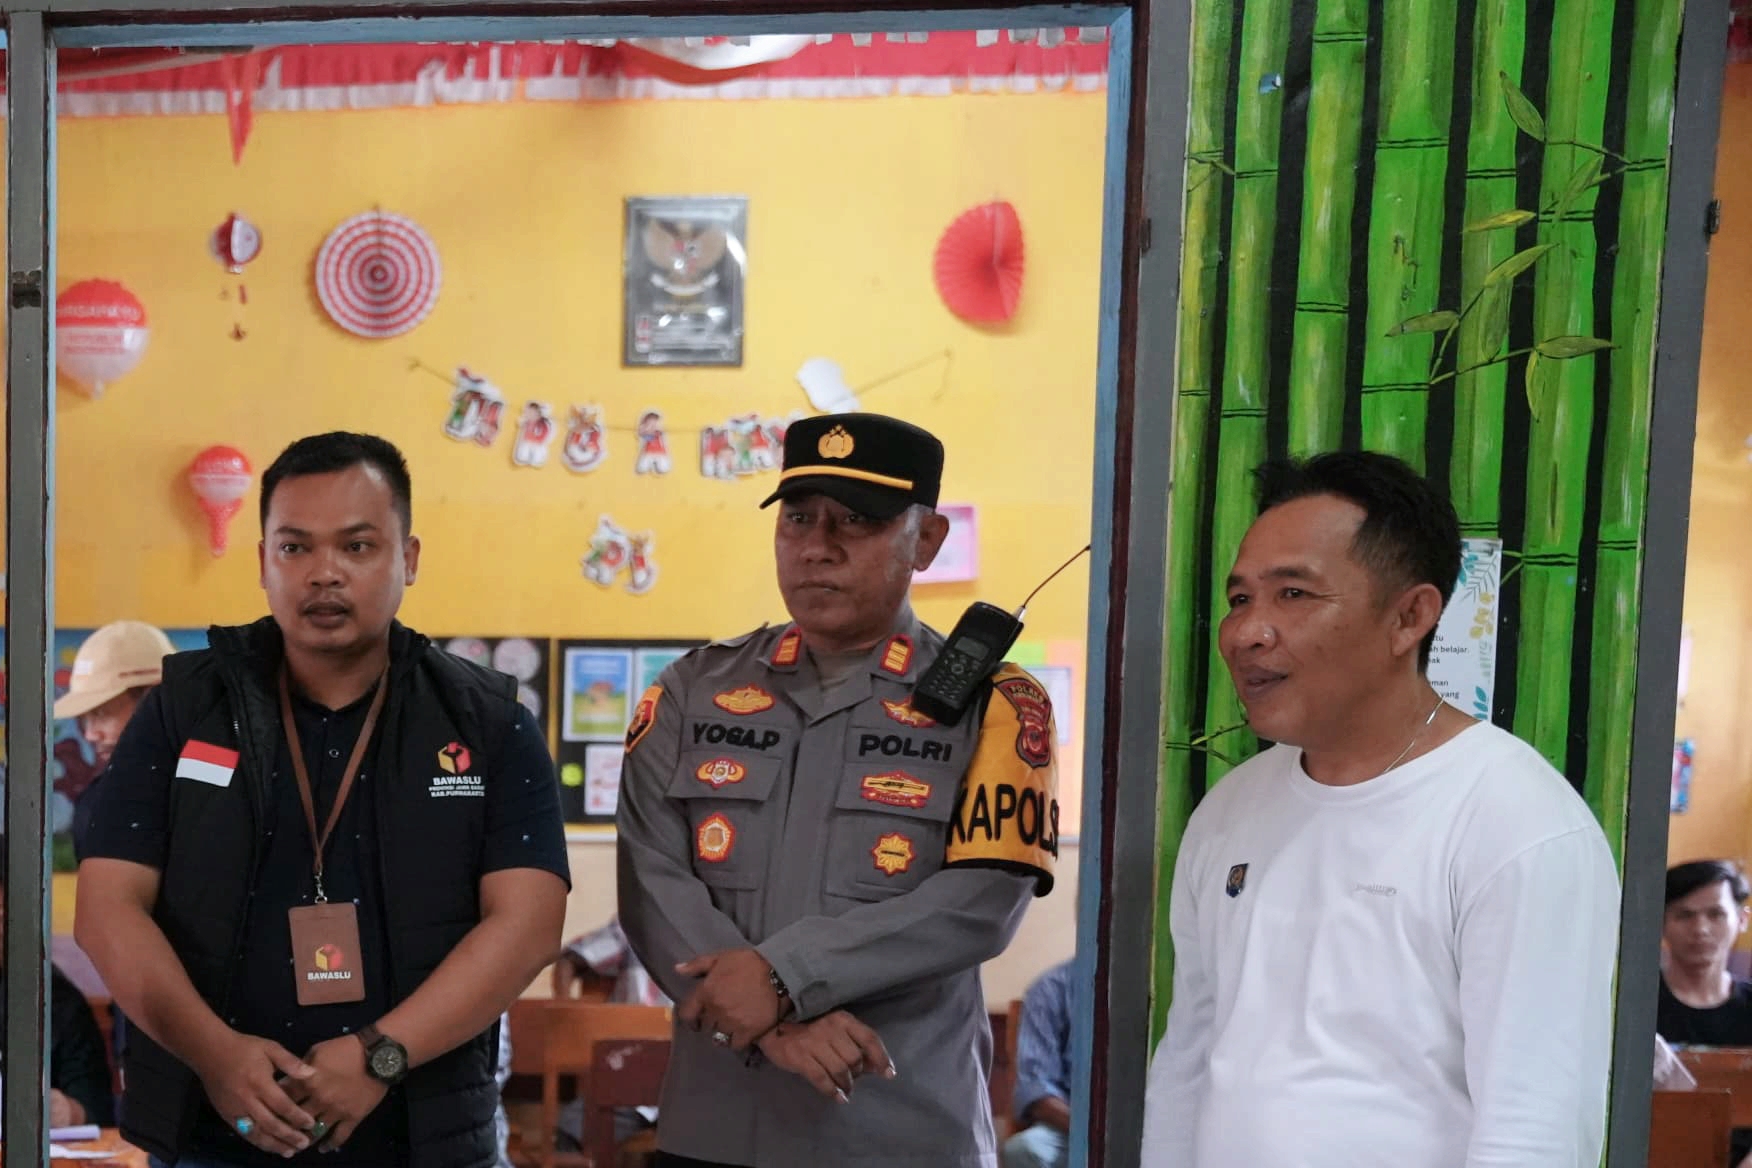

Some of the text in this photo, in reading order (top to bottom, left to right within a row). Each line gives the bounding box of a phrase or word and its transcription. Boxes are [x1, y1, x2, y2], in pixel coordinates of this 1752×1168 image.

[693, 723, 780, 751] YOGA.P
[859, 734, 952, 762] POLRI
[432, 776, 482, 786] BAWASLU
[307, 971, 351, 981] BAWASLU
